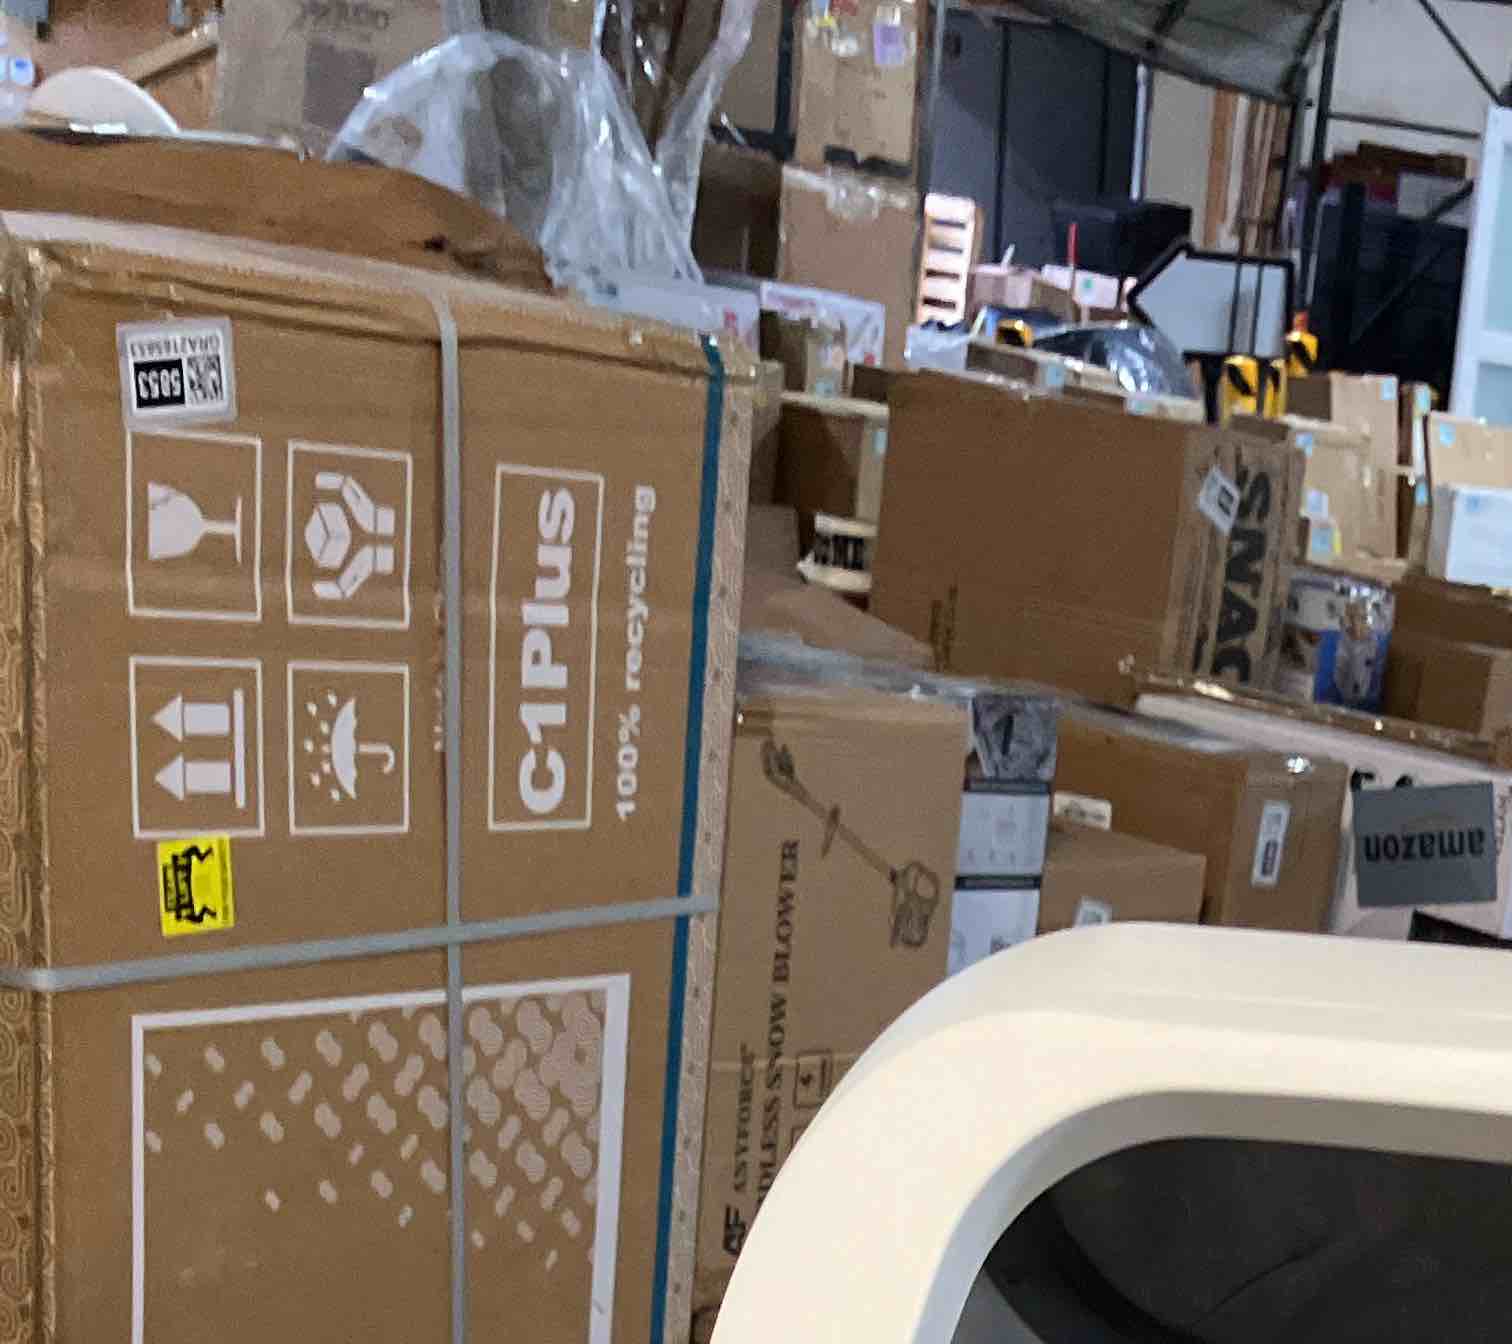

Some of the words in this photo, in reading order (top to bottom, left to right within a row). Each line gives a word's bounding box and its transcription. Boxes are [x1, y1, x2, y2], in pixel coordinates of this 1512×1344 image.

[625, 484, 657, 692] recycling
[615, 704, 641, 822] 100%
[1363, 827, 1487, 863] amazon
[772, 840, 800, 983] BLOWER
[765, 993, 787, 1090] SNOW
